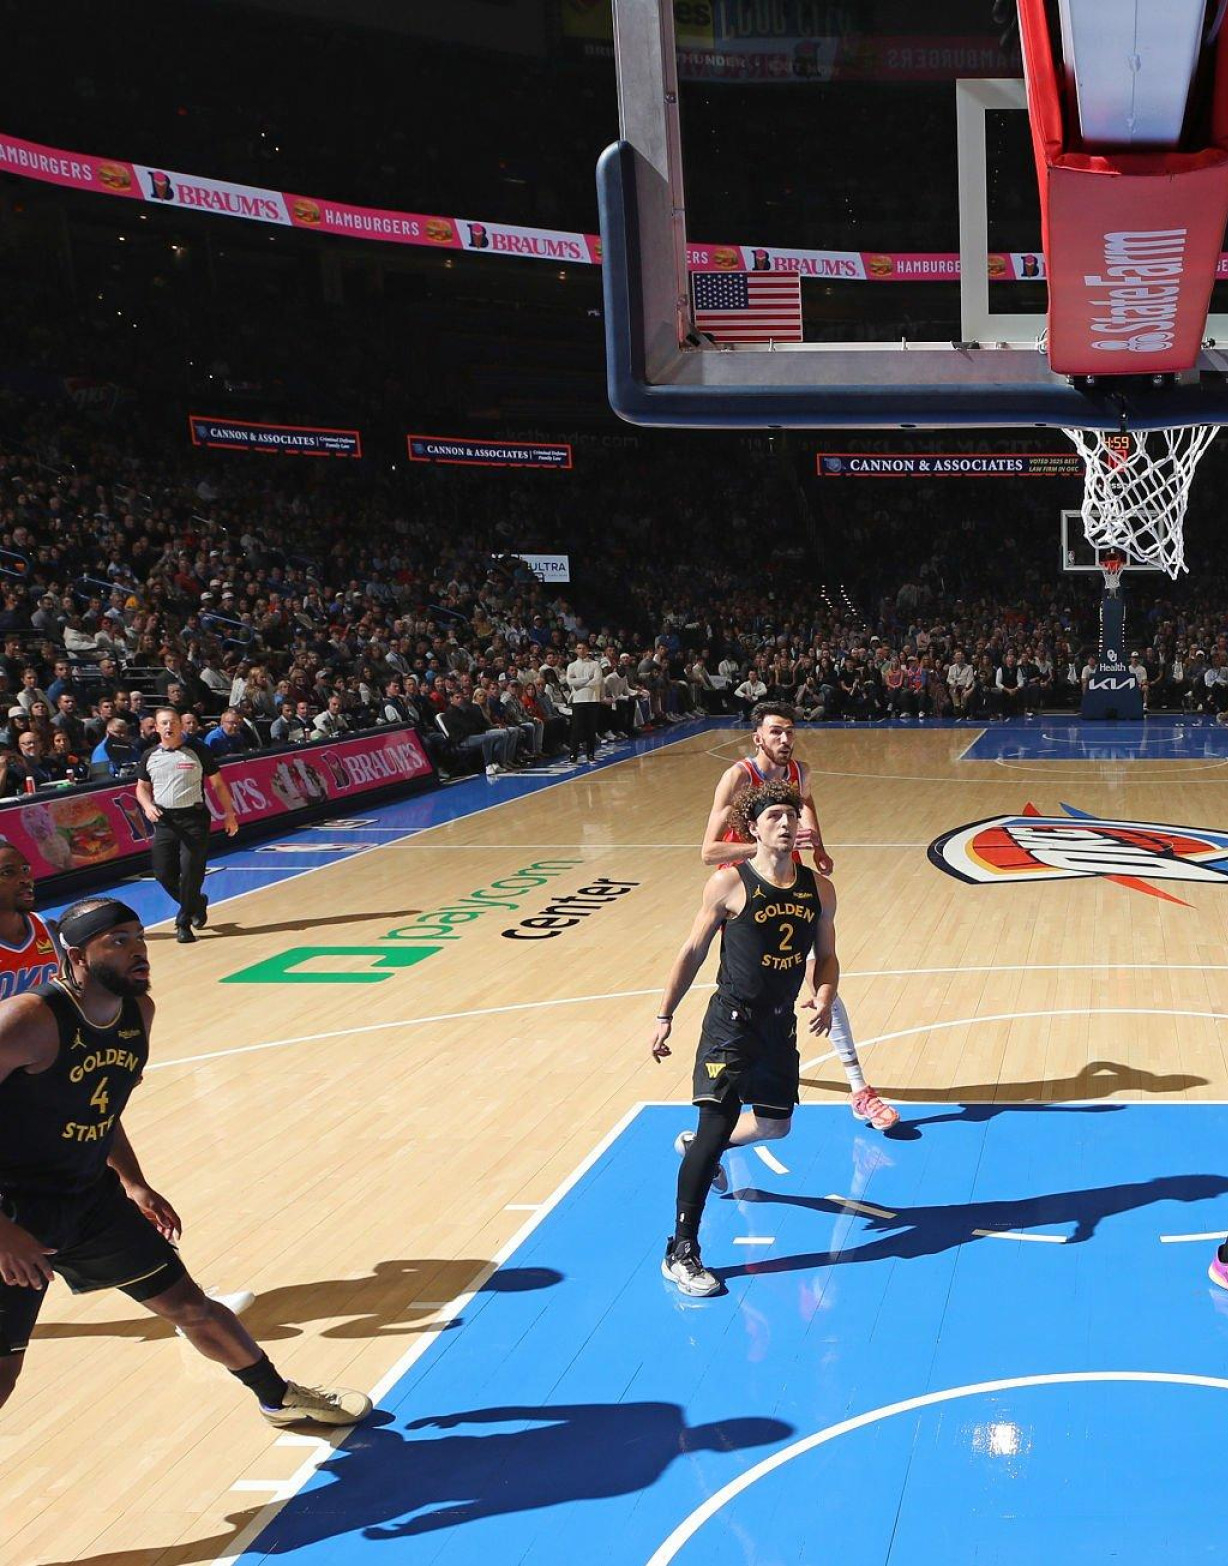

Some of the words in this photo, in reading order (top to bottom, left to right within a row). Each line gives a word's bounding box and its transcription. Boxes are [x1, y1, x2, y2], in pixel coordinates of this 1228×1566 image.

[177, 184, 280, 221] BRAUM'S
[325, 209, 420, 236] HAMBURGERS
[492, 233, 583, 260] BRAUM'S
[774, 257, 859, 277] BRAUM'S
[896, 260, 961, 274] HAMBURGE
[210, 427, 248, 441] CANNON
[250, 432, 256, 441] &
[258, 433, 315, 446] ASSOCIATES
[427, 444, 465, 456] CANNON
[467, 447, 473, 456] &
[474, 448, 529, 460] ASSOCIATES
[850, 459, 914, 471] CANNON
[919, 459, 930, 471] &
[933, 459, 1023, 471] ASSOCIATES
[531, 562, 566, 571] ULTRA
[1100, 662, 1126, 672] Health
[1089, 677, 1136, 690] KIA
[344, 742, 426, 786] BRAUM'S
[209, 778, 268, 823] UM'S
[379, 859, 584, 941] paycom
[501, 877, 641, 941] center
[754, 903, 815, 924] GOLDEN
[779, 923, 794, 951] 2
[761, 952, 803, 970] STATE
[69, 1048, 139, 1083] GOLDEN
[90, 1076, 109, 1114] 4
[62, 1114, 115, 1142] STATE
